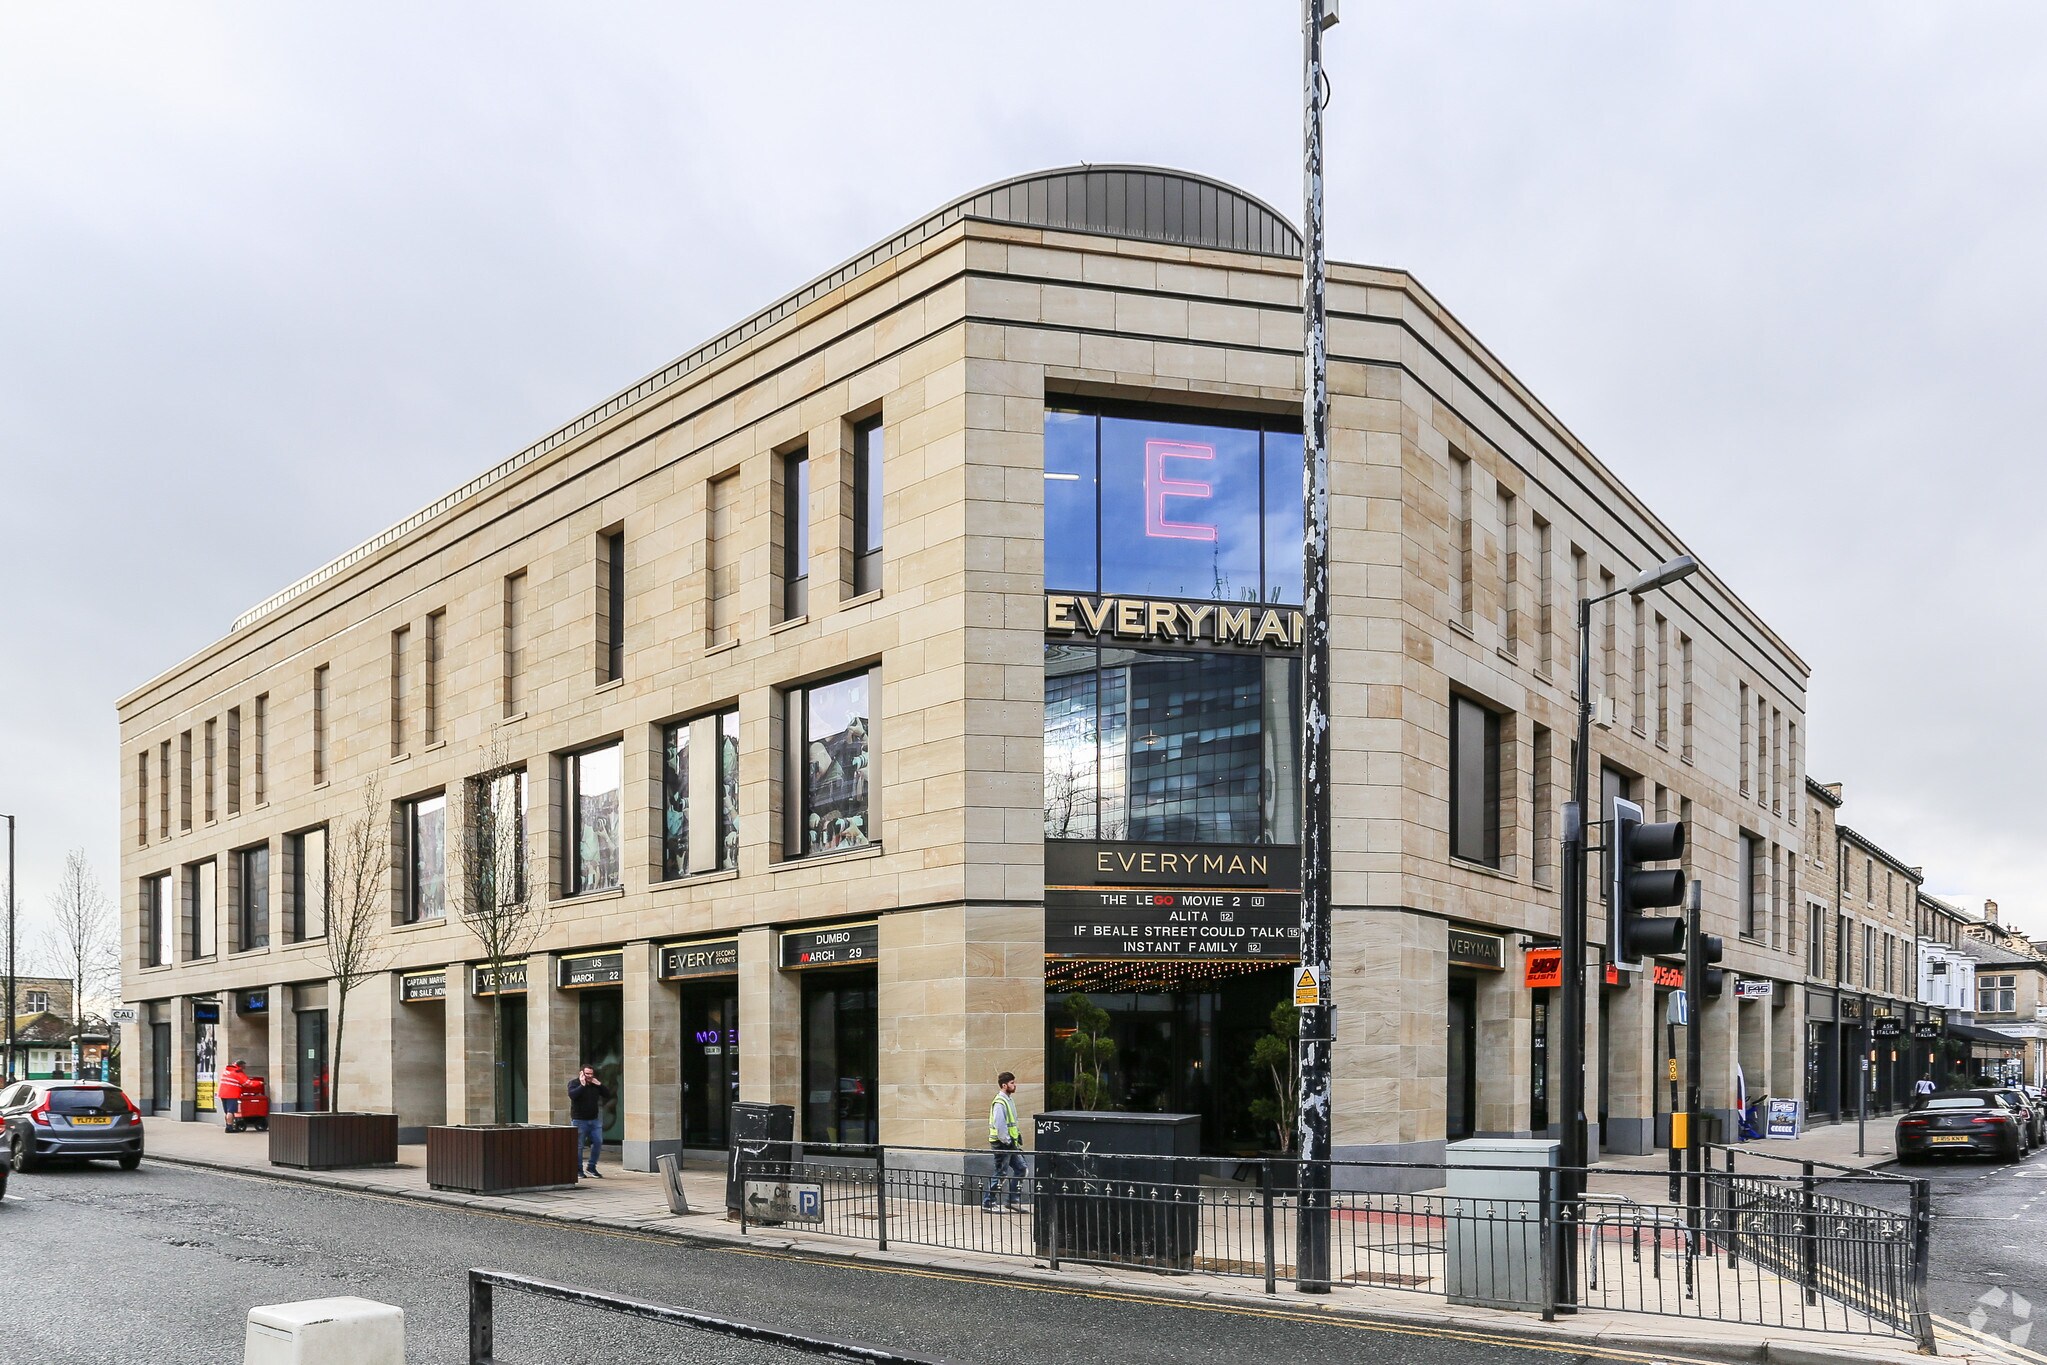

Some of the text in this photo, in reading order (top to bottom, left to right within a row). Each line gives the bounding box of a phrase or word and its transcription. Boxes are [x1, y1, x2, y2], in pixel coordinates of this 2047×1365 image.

[1145, 438, 1217, 541] E
[1097, 851, 1268, 875] EVERYMAN
[1101, 894, 1127, 905] THE
[1136, 895, 1174, 906] LEGO
[1182, 895, 1224, 906] MOVIE
[1232, 896, 1241, 906] 2
[1169, 911, 1208, 921] ALITA
[1073, 925, 1087, 936] IF
[1093, 925, 1138, 936] BEALE
[1144, 926, 1197, 937] STREET
[1200, 926, 1245, 937] COULD
[1250, 927, 1284, 937] TALK
[816, 932, 850, 945] DUMBO
[1123, 941, 1180, 952] INSTANT
[1188, 942, 1238, 952] FAMILY
[1449, 938, 1497, 958] VERYMAN
[668, 950, 715, 969] EVERY
[715, 949, 736, 958] SECOND
[800, 948, 862, 963] MARCH 29
[592, 958, 602, 968] US
[715, 956, 736, 965] COUNTS
[406, 977, 428, 987] CAPTAIN
[571, 971, 619, 984] MARCH 22
[410, 989, 418, 998] ON
[419, 988, 433, 997] SALE
[1746, 984, 1770, 995] F45
[113, 1011, 134, 1019] CAU
[774, 1186, 792, 1199] Car
[770, 1200, 797, 1214] Parks
[803, 1194, 815, 1213] P
